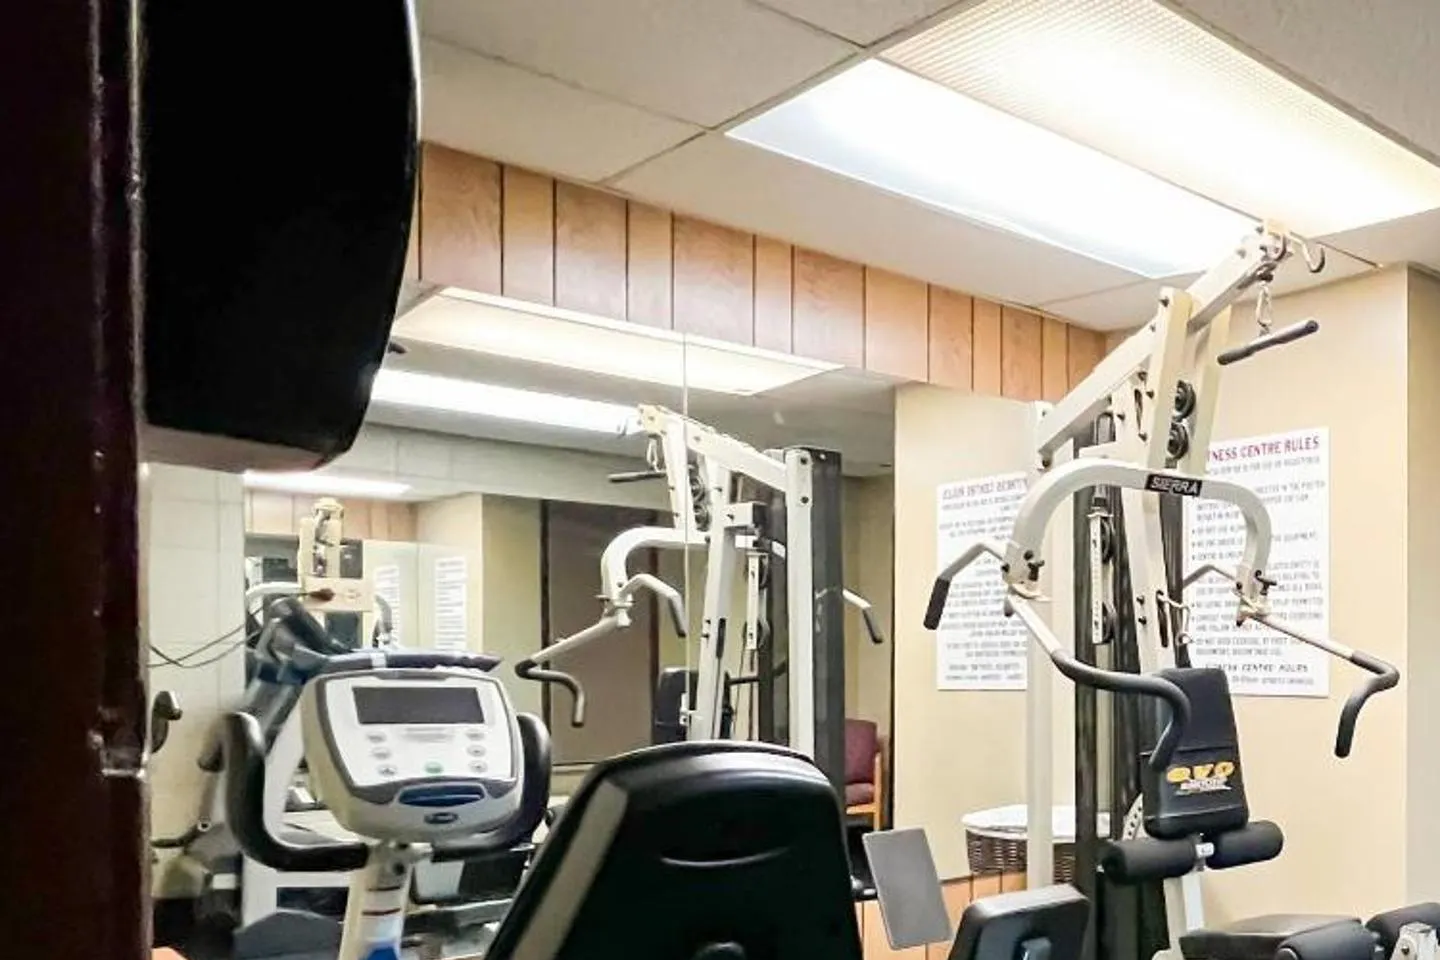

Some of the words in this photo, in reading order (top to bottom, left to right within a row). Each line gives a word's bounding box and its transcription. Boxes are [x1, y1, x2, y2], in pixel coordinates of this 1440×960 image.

[1240, 441, 1281, 459] CENTRE
[1284, 435, 1320, 455] RULES
[1151, 476, 1199, 496] SIERRA
